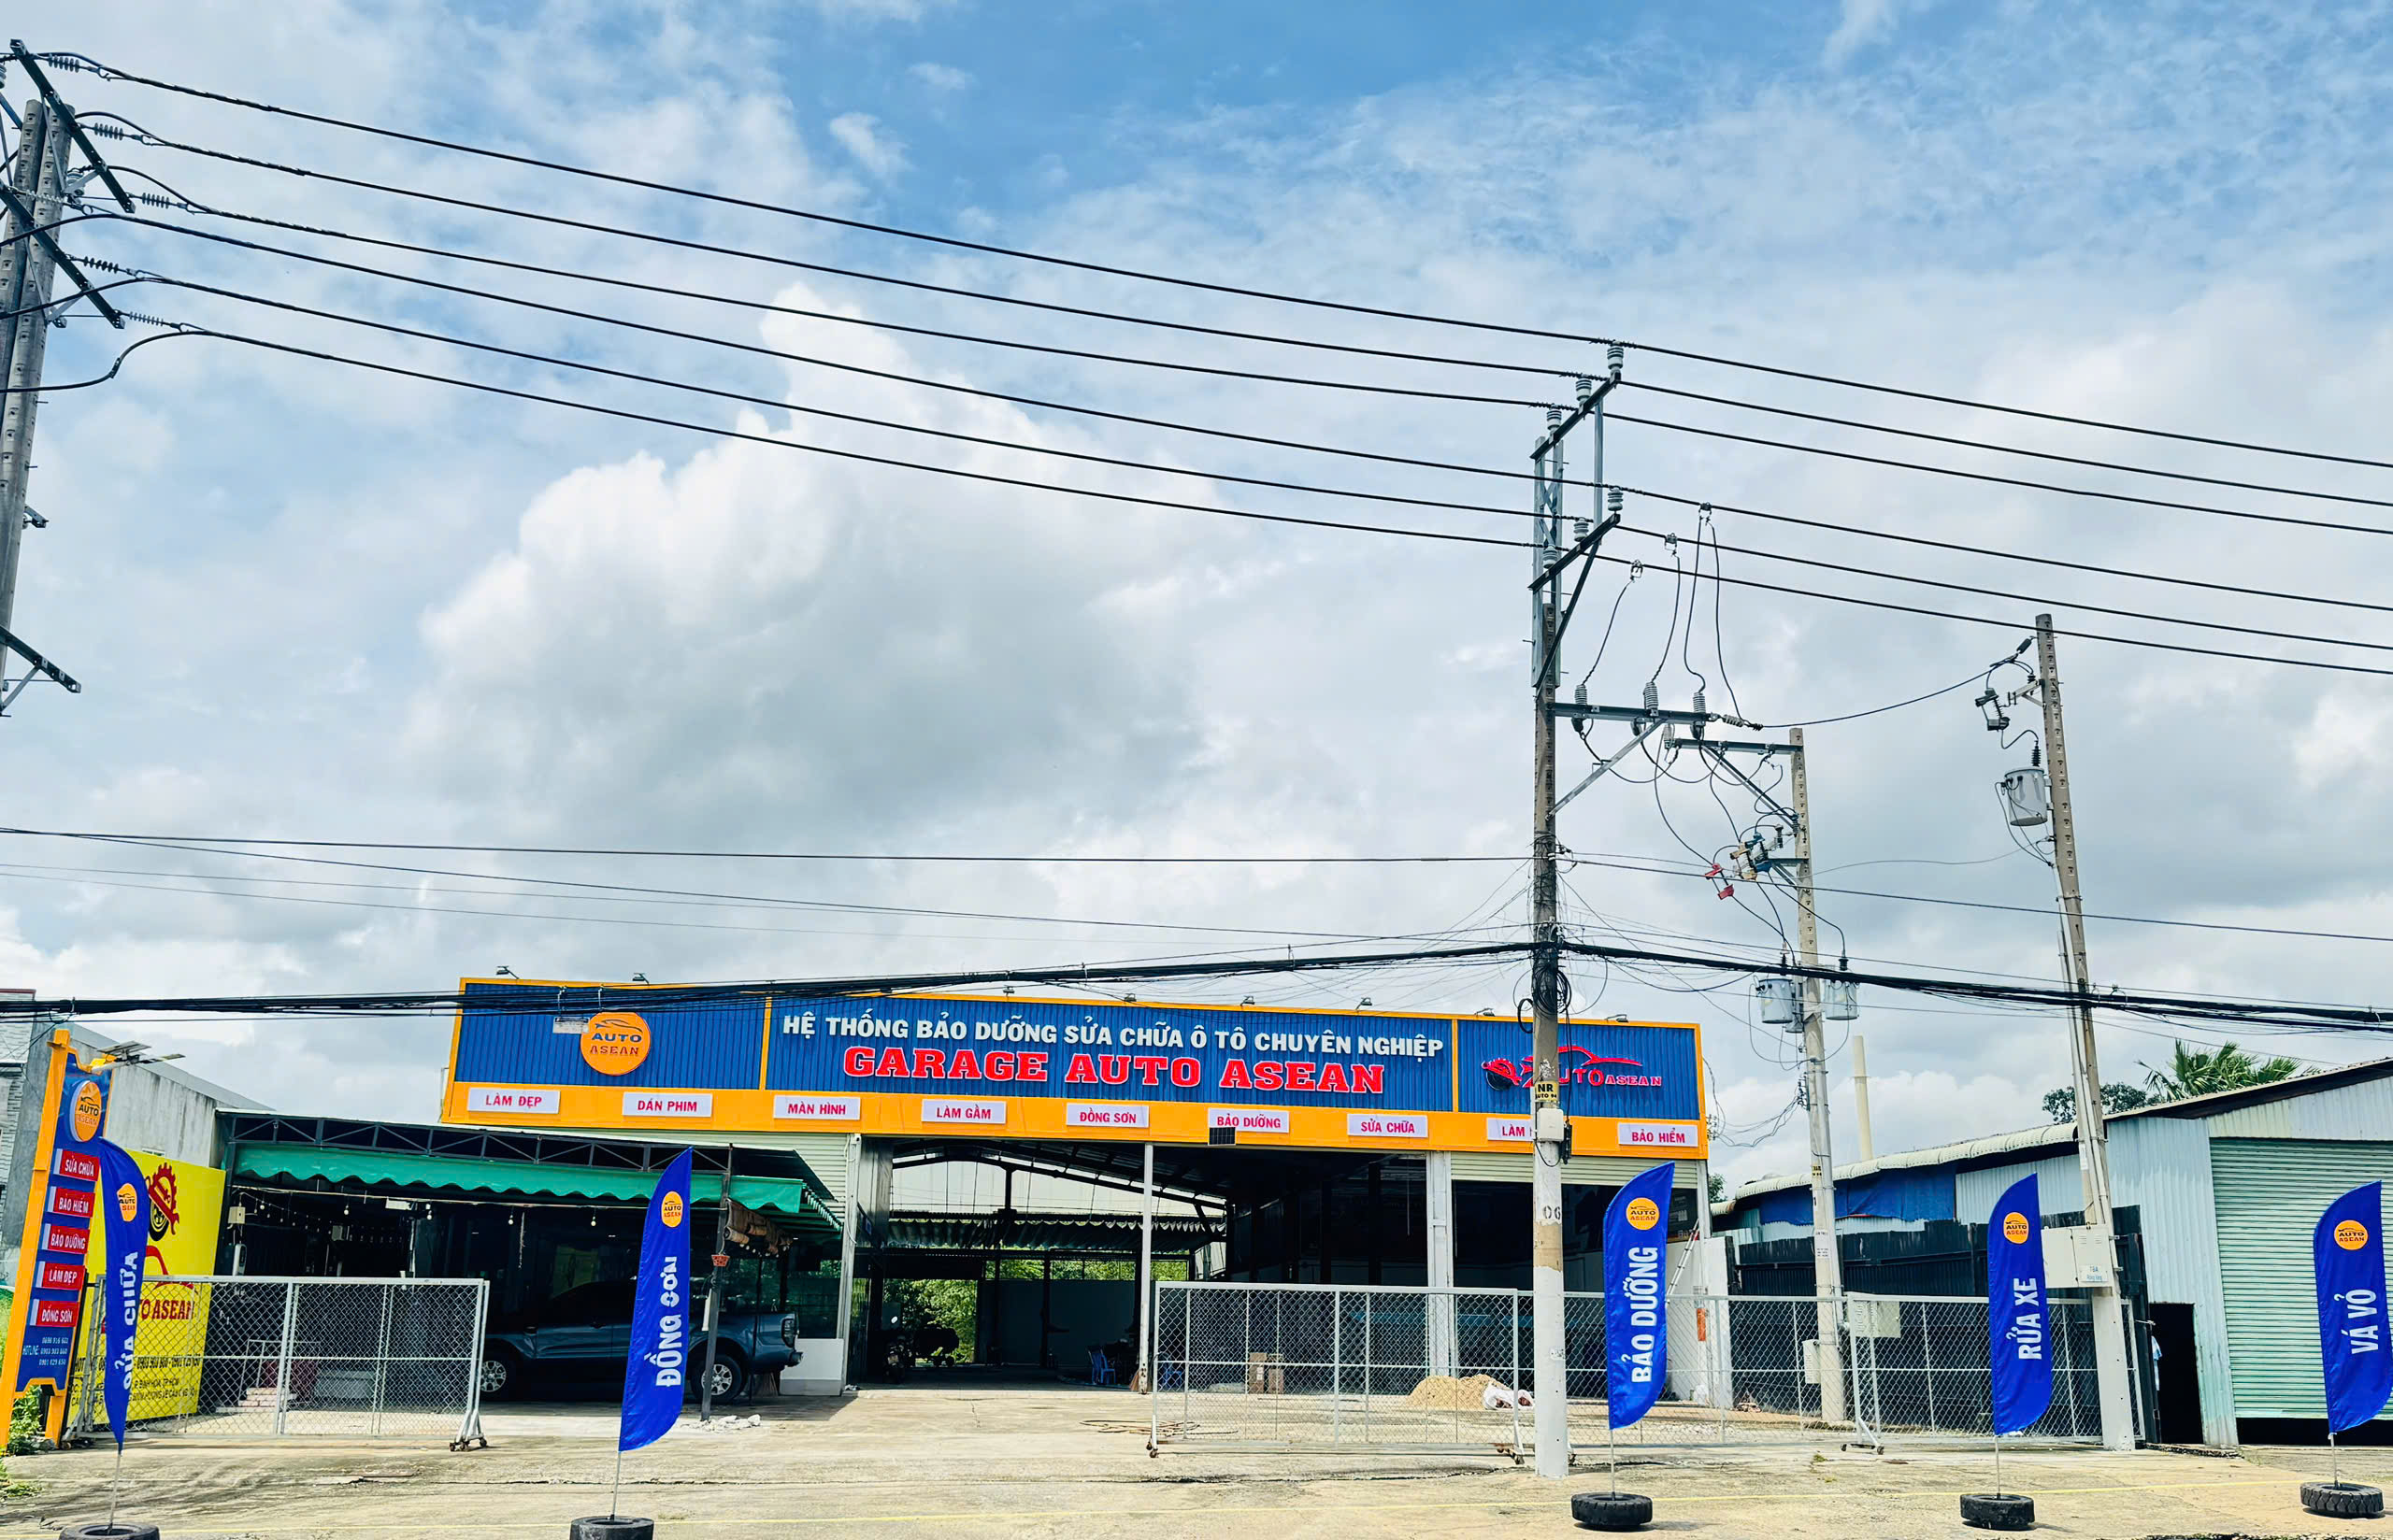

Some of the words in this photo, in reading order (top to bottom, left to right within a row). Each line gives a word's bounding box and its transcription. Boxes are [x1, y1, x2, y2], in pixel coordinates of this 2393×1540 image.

[592, 1033, 642, 1043] AUTO
[784, 1012, 816, 1039] HỆ
[825, 1009, 909, 1037] THỐNG
[916, 1012, 967, 1040] BẢO
[975, 1015, 1057, 1044] DƯỠNG
[1064, 1016, 1112, 1045] SỬA
[1120, 1021, 1182, 1048] CHỮA
[1190, 1024, 1207, 1048] Ô
[1214, 1026, 1247, 1050] TÔ
[1254, 1030, 1352, 1054] CHUYÊN
[1358, 1034, 1443, 1062] NGHIỆP
[590, 1046, 639, 1055] ASEAN
[843, 1046, 1049, 1082] GARAGE
[1065, 1053, 1201, 1088] AUTO
[1219, 1059, 1385, 1094] ASEAN
[1538, 1083, 1554, 1092] NR
[1605, 1075, 1662, 1087] ASEAN
[486, 1094, 513, 1106] LÀM
[519, 1095, 543, 1109] ĐẸP
[637, 1098, 663, 1111] DÁN
[666, 1100, 698, 1112] PHIM
[788, 1102, 815, 1115] MÀN
[819, 1103, 847, 1115] HÌNH
[79, 1104, 99, 1117] AUTO
[937, 1105, 962, 1119] LÀM
[965, 1105, 992, 1119] GẦM
[1080, 1109, 1110, 1123] ĐỒNG
[1113, 1113, 1138, 1124] SƠN
[1216, 1114, 1240, 1128] BẢO
[1242, 1115, 1282, 1129] DƯỠNG
[1360, 1119, 1383, 1133] SỬA
[1385, 1119, 1415, 1134] CHỮA
[1502, 1124, 1526, 1137] LÀM
[1631, 1129, 1655, 1143] BẢO
[1658, 1129, 1685, 1143] HIỂM
[660, 1256, 680, 1307] SƠN
[1623, 1247, 1658, 1326] DƯỠNG
[2013, 1277, 2039, 1306] XE
[2333, 1289, 2378, 1319] VỎ
[2006, 1313, 2042, 1360] RỬA
[2341, 1325, 2379, 1354] VÁ
[644, 1314, 682, 1387] ĐỒNG
[1621, 1334, 1655, 1383] BẢO
